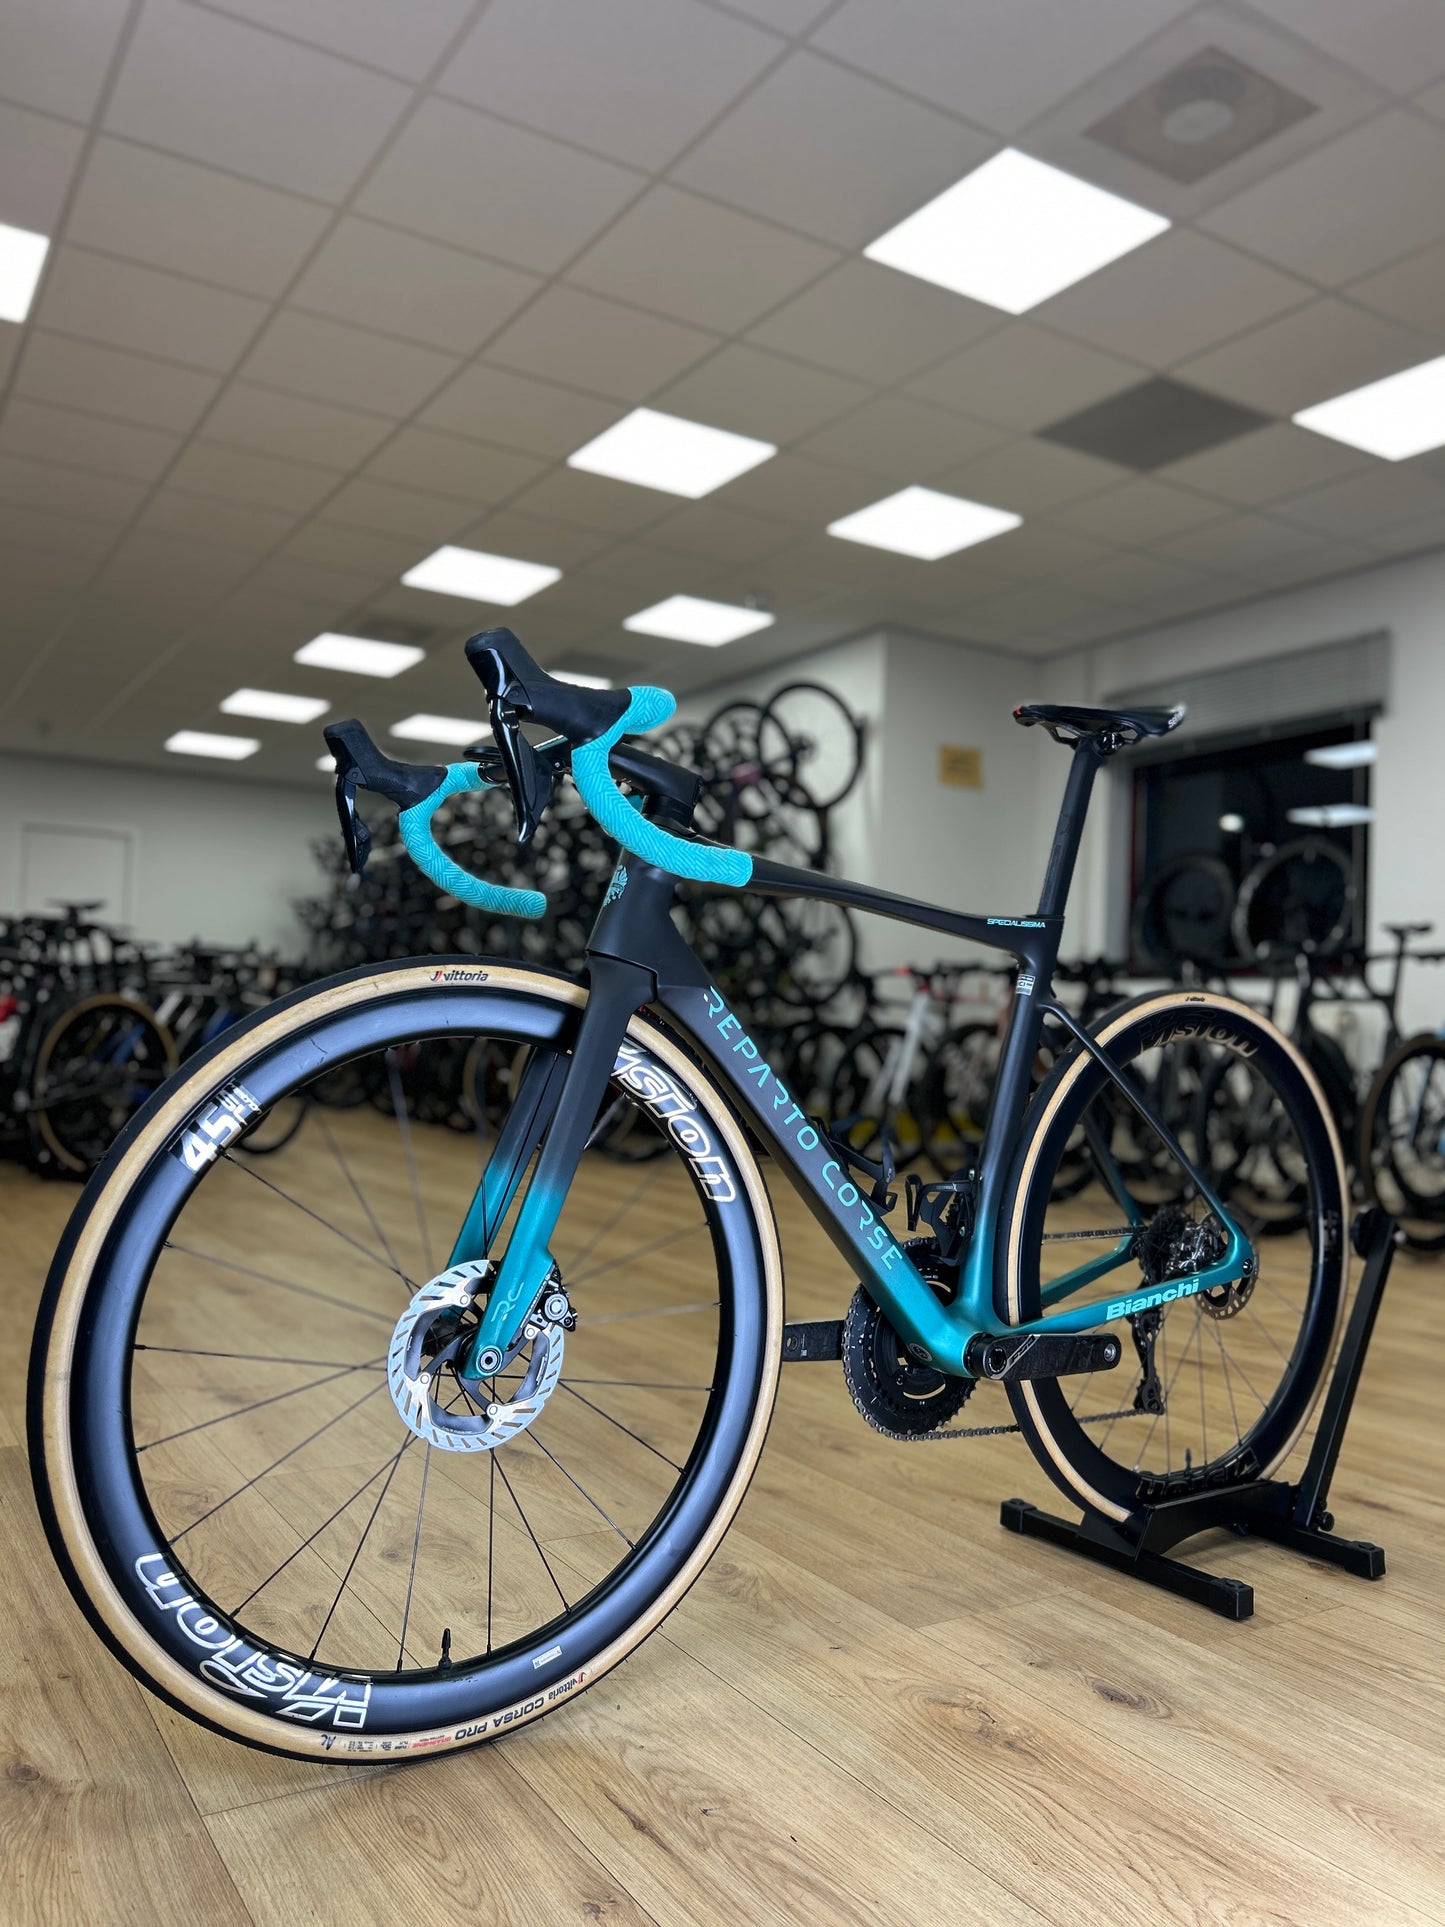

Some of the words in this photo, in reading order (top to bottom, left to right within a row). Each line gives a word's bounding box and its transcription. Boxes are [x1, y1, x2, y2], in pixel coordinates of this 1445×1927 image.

[443, 969, 489, 981] vittoria
[179, 1101, 242, 1173] 45
[703, 986, 820, 1151] REPARTO
[821, 1160, 903, 1271] CORSE
[1106, 1278, 1200, 1321] Bianchi
[493, 1696, 545, 1728] CORSA
[454, 1721, 488, 1741] PRO
